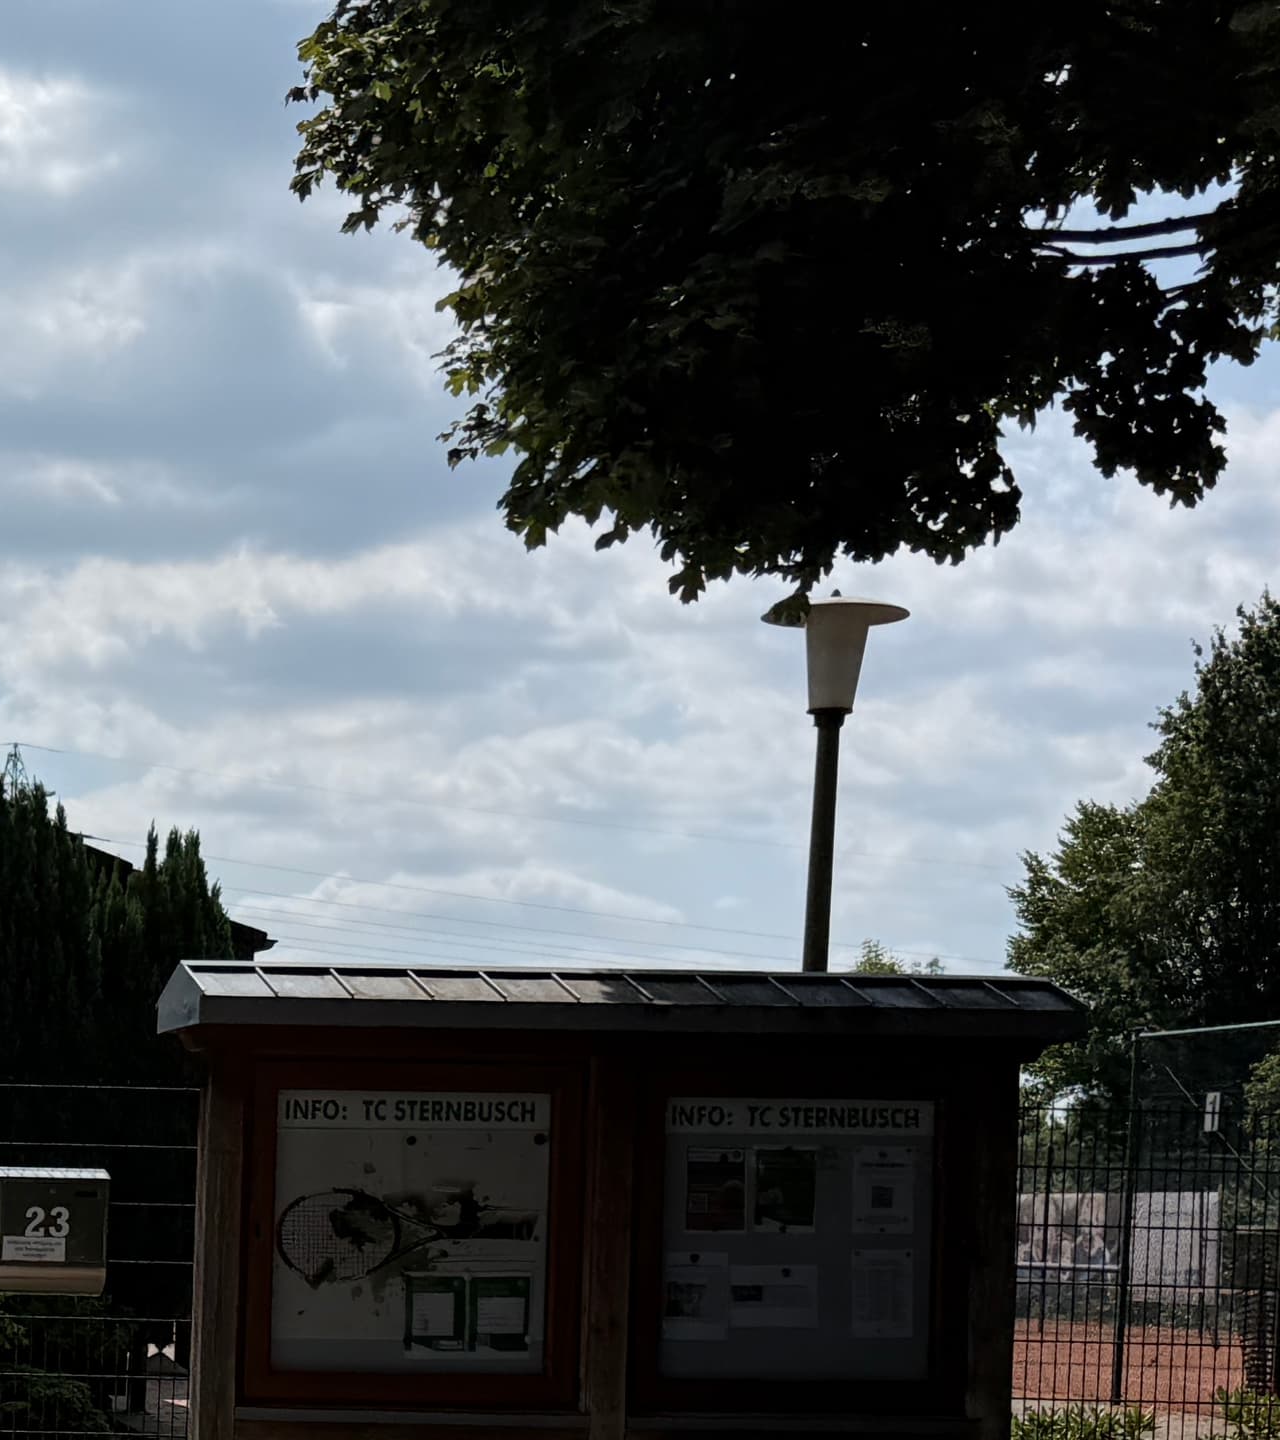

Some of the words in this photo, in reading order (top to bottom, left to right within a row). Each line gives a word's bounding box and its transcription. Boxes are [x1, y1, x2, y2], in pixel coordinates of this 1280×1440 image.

[284, 1099, 348, 1120] INFO:
[362, 1100, 387, 1121] TC
[394, 1101, 536, 1122] STERNBUSCH
[671, 1105, 733, 1127] INFO:
[747, 1106, 772, 1127] TC
[778, 1106, 920, 1128] STERNBUSCH
[24, 1205, 71, 1238] 23
